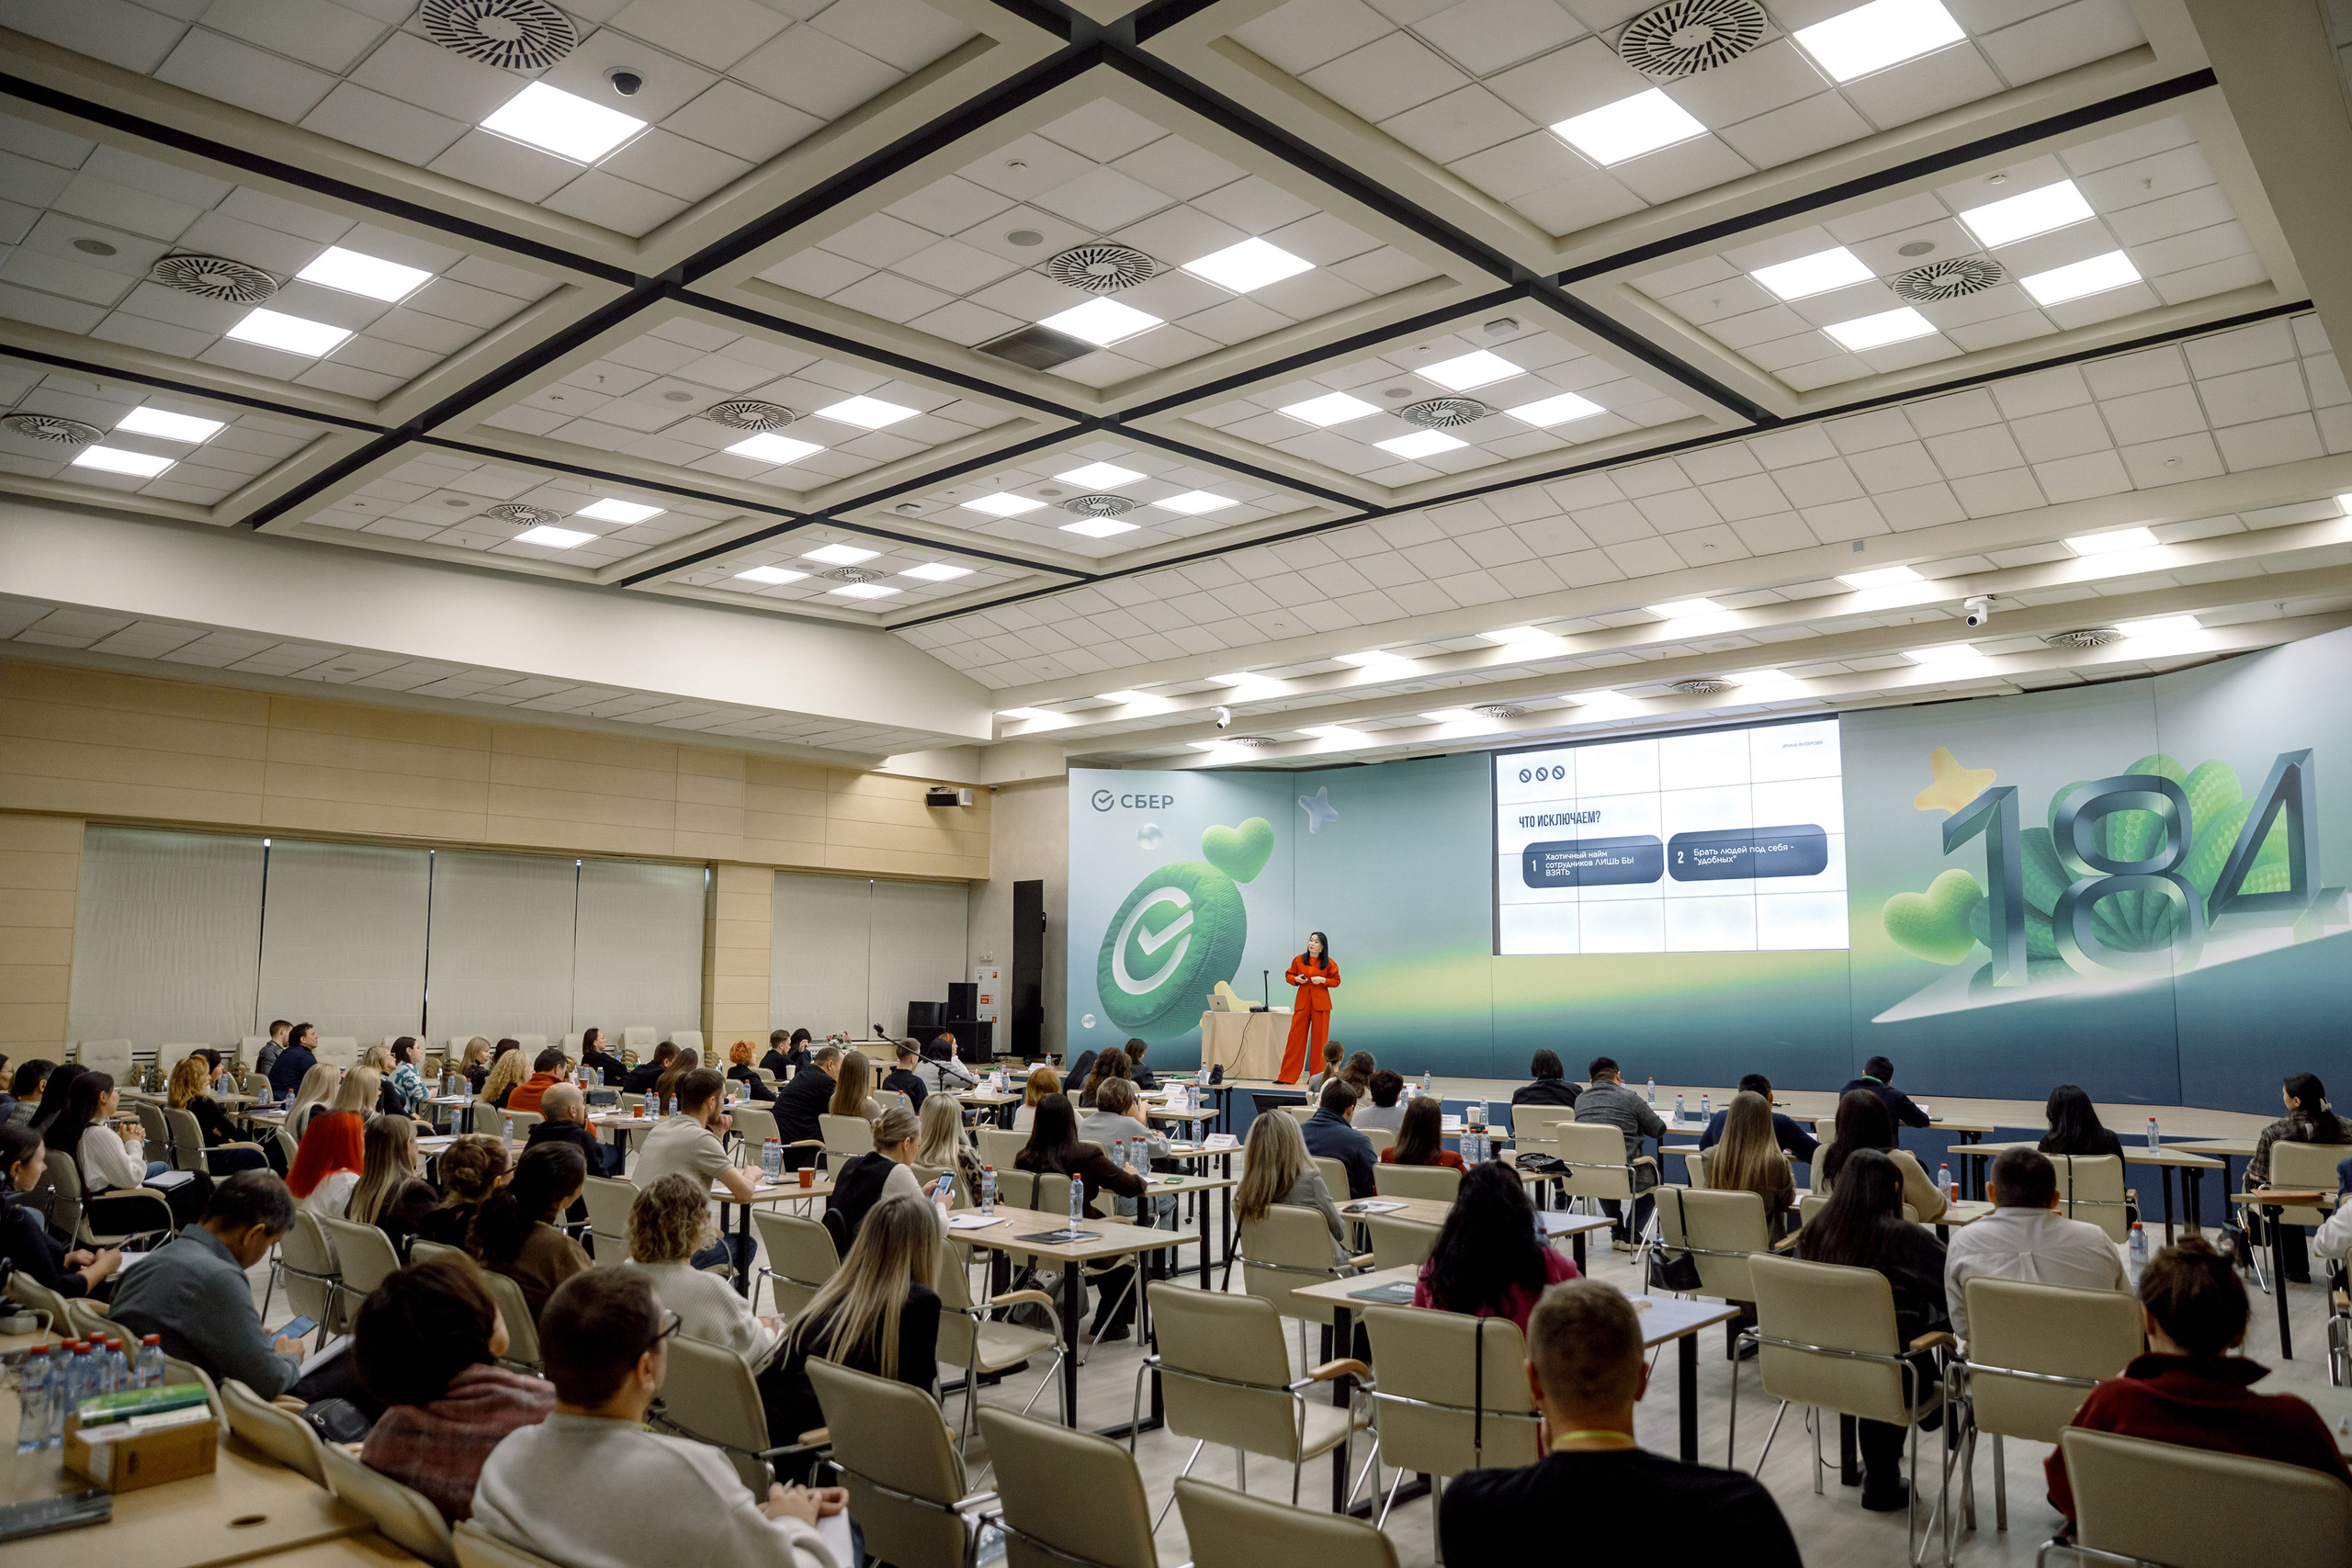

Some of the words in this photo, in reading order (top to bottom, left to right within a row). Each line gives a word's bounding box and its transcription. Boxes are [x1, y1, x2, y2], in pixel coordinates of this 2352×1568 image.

[1120, 794, 1174, 809] СБЕР
[1519, 815, 1535, 829] ЧТО
[1537, 810, 1601, 827] ИСКЛЮЧАЕМ?
[1545, 851, 1587, 861] Хаотичный
[1677, 851, 1684, 863] 2
[1693, 848, 1718, 857] Брать
[1720, 845, 1747, 855] людей
[1749, 846, 1766, 854] под
[1768, 843, 1788, 852] себя
[1532, 860, 1537, 872] 1
[1545, 861, 1593, 870] сотрудников
[1595, 858, 1620, 866] ЛИШЬ
[1622, 856, 1634, 864] БЫ
[1693, 855, 1737, 865] "удобных"
[1942, 748, 2350, 987] 184
